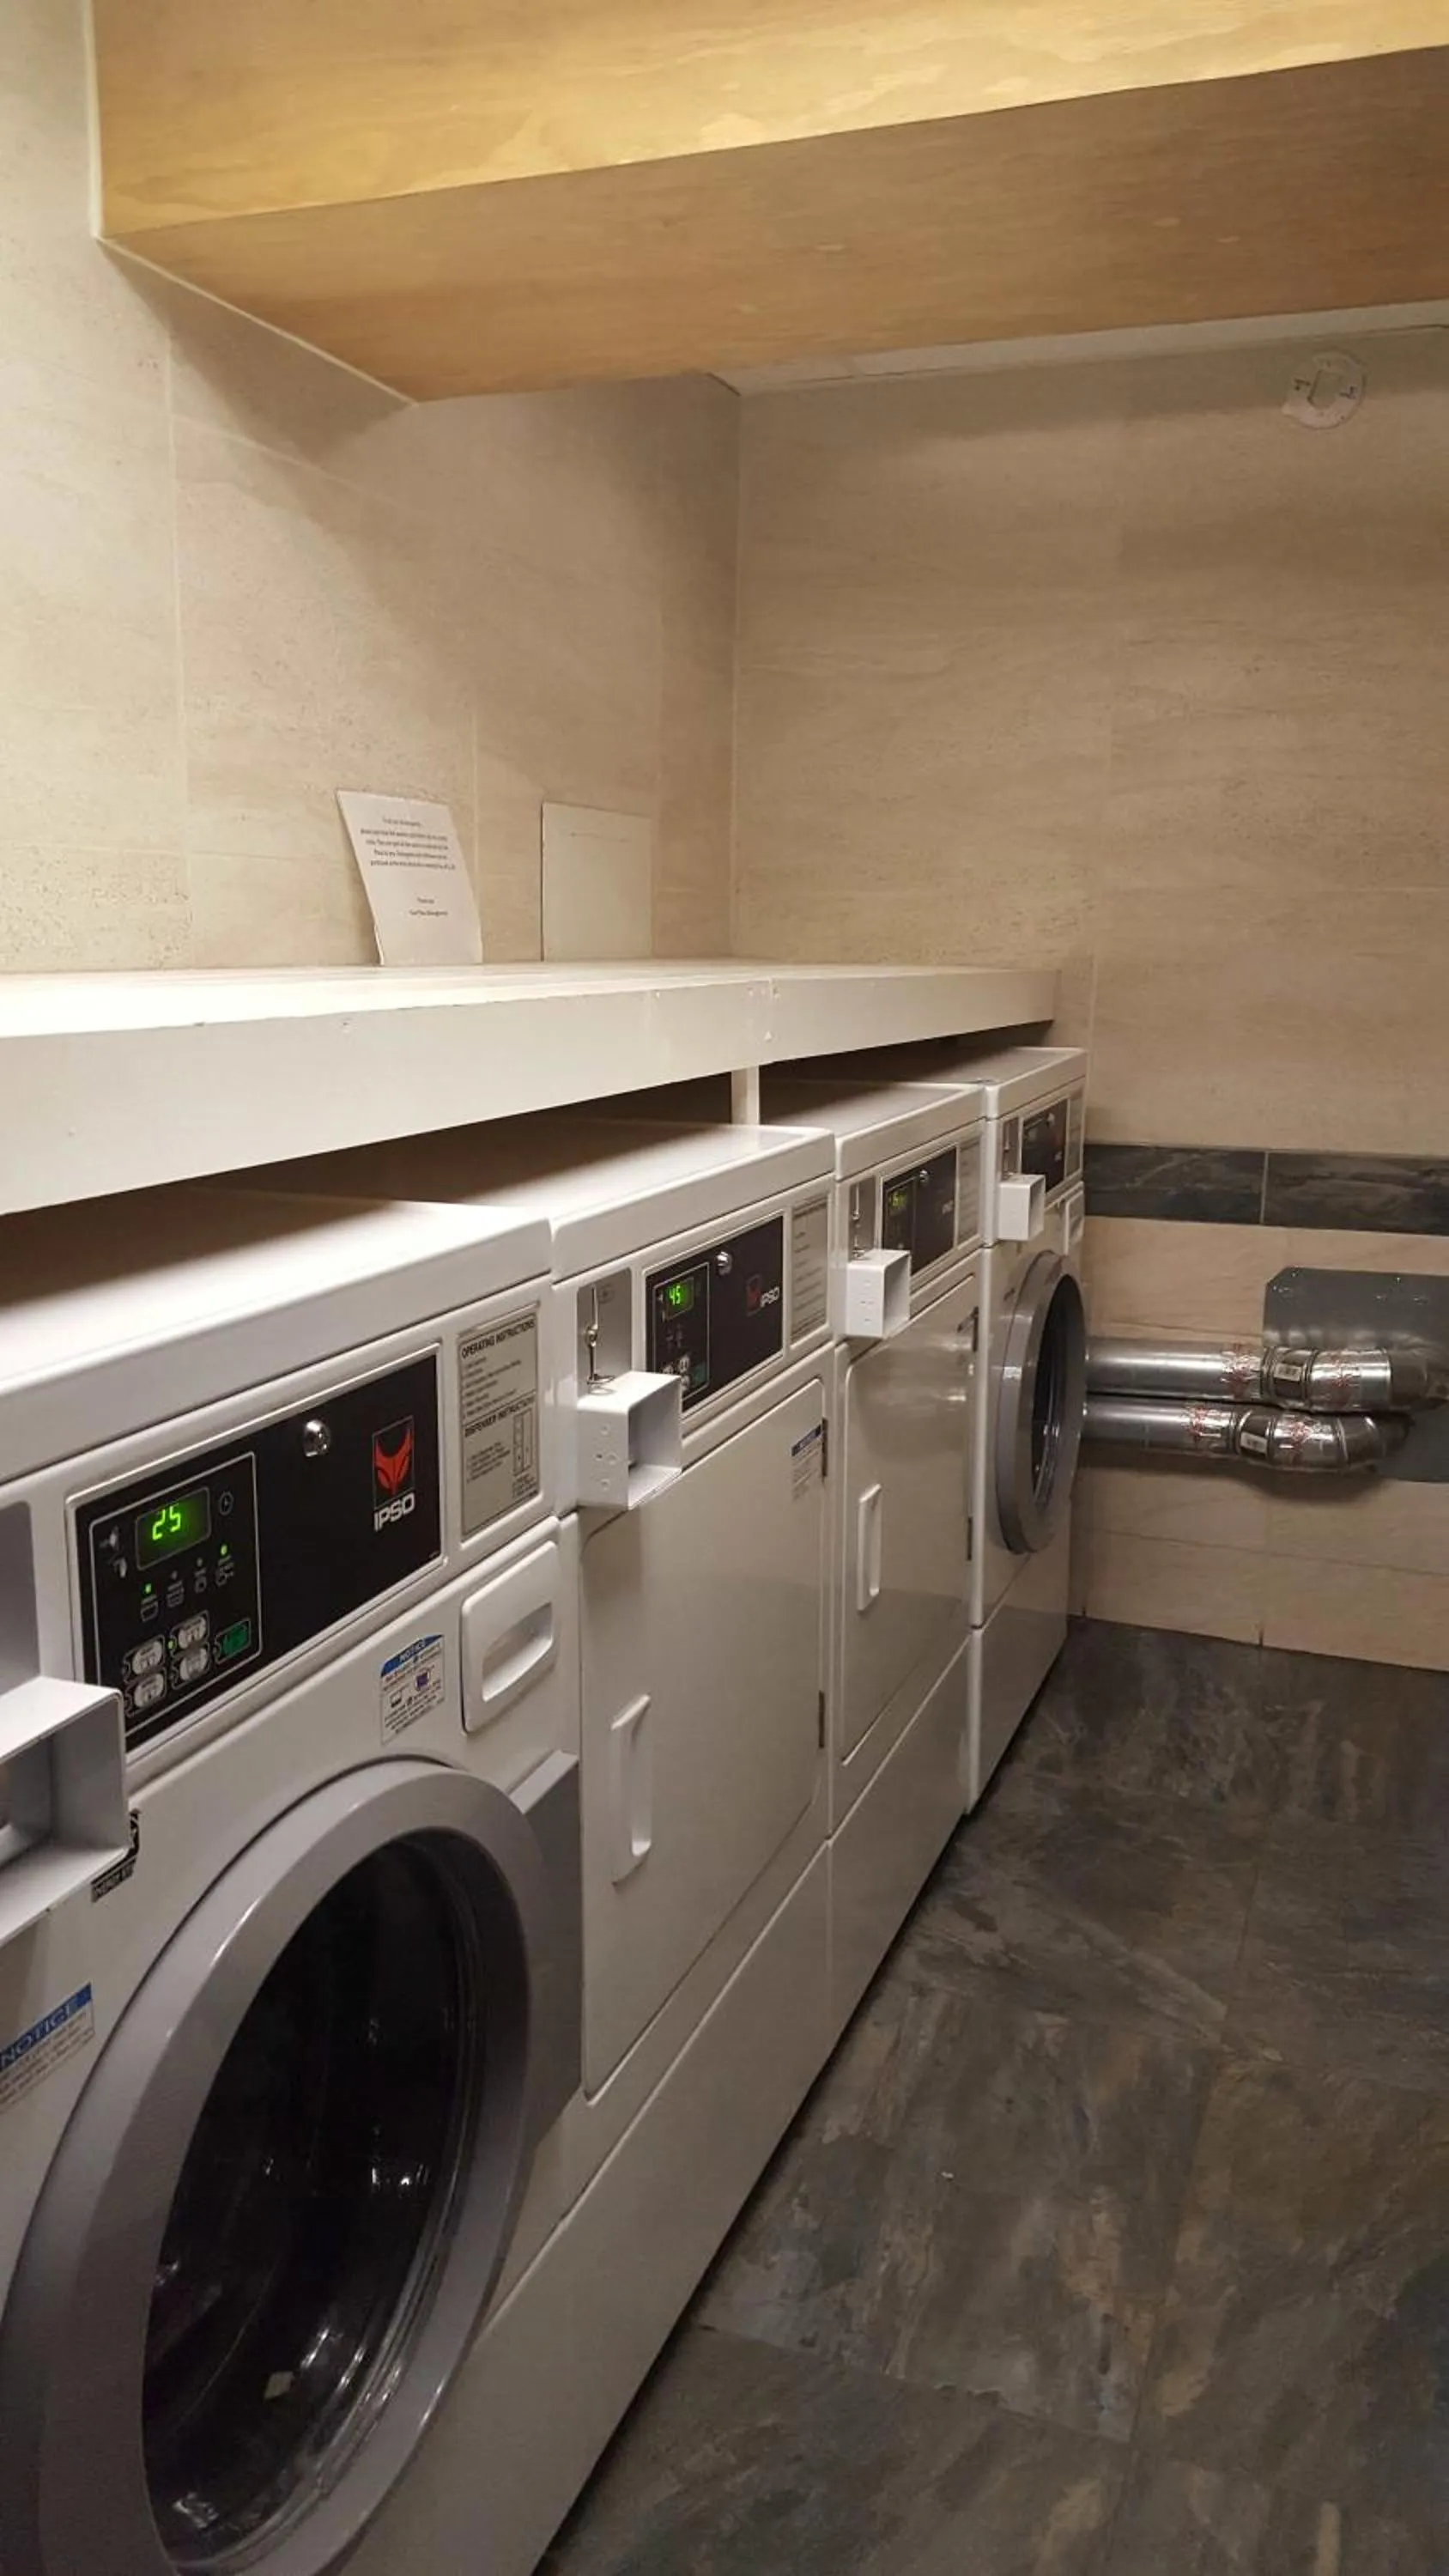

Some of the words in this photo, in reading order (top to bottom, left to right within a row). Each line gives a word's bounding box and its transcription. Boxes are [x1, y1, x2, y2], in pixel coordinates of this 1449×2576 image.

[670, 1285, 681, 1304] 45
[153, 1504, 181, 1540] 25
[373, 1492, 415, 1532] IPSO
